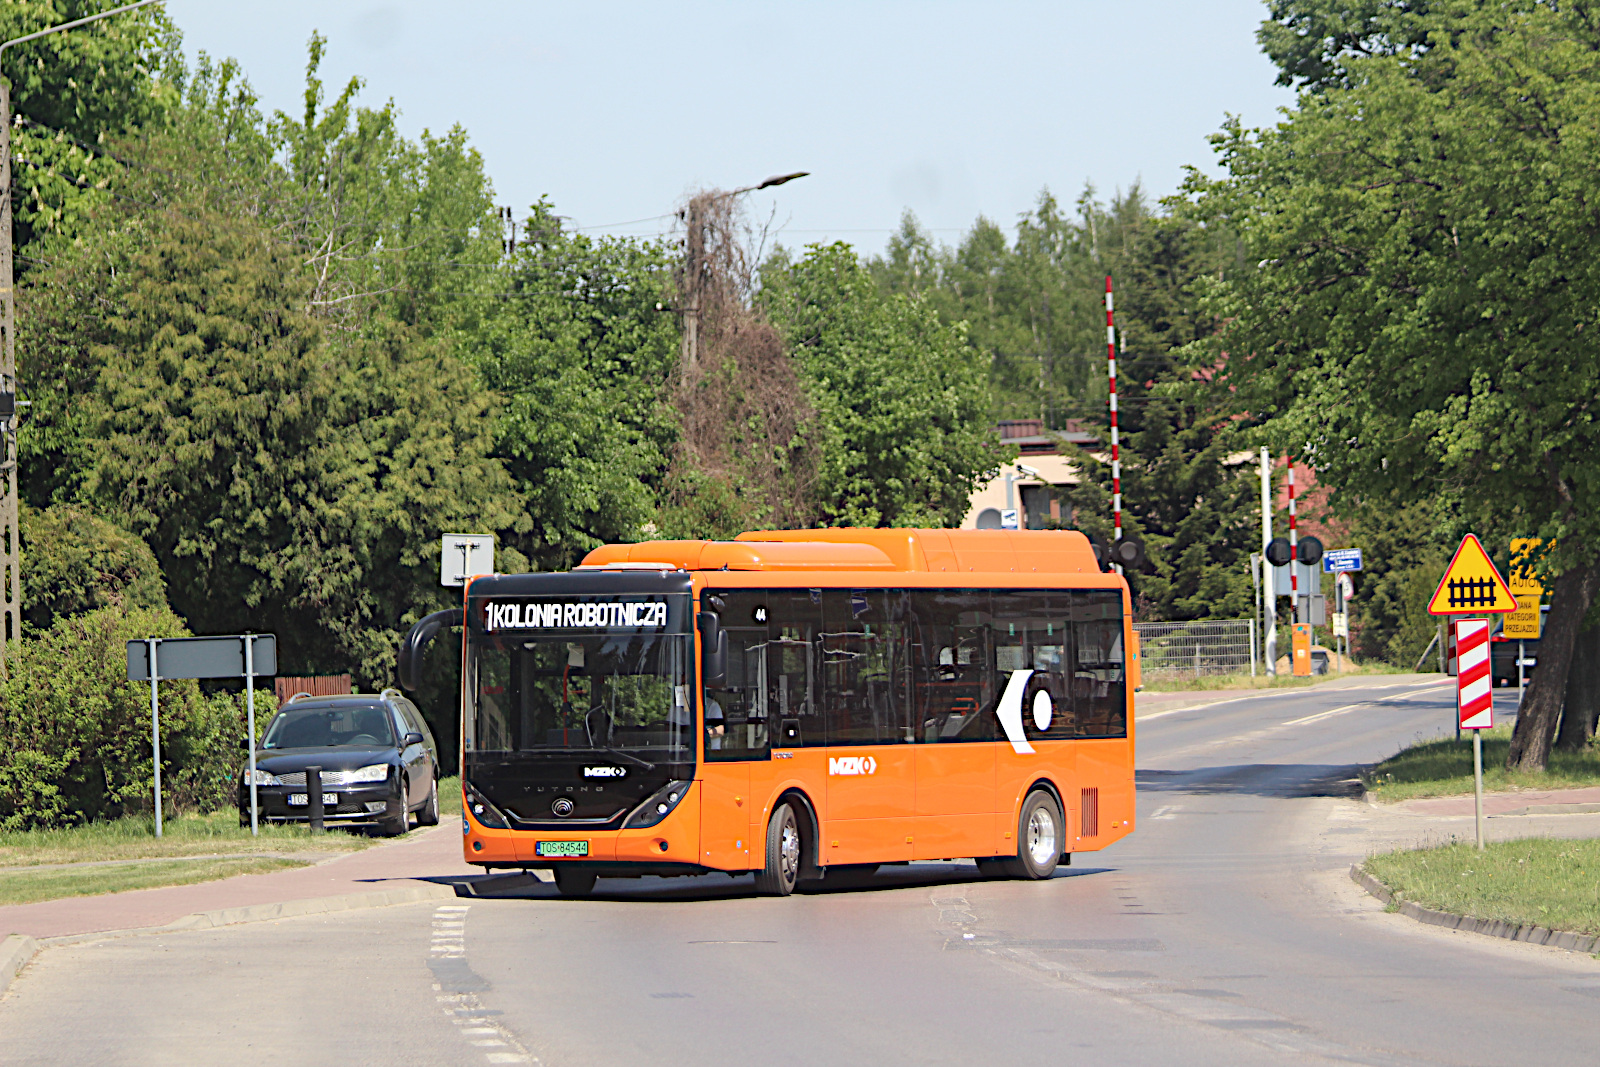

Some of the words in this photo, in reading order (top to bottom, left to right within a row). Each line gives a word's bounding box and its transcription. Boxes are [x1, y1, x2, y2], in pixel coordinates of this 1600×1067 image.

[485, 602, 494, 632] 1
[493, 603, 562, 628] KOLONIA
[563, 602, 667, 627] ROBOTNICZA
[755, 608, 766, 622] 44
[1506, 612, 1536, 621] KATEGORII
[1505, 624, 1537, 633] PRZEJAZDU
